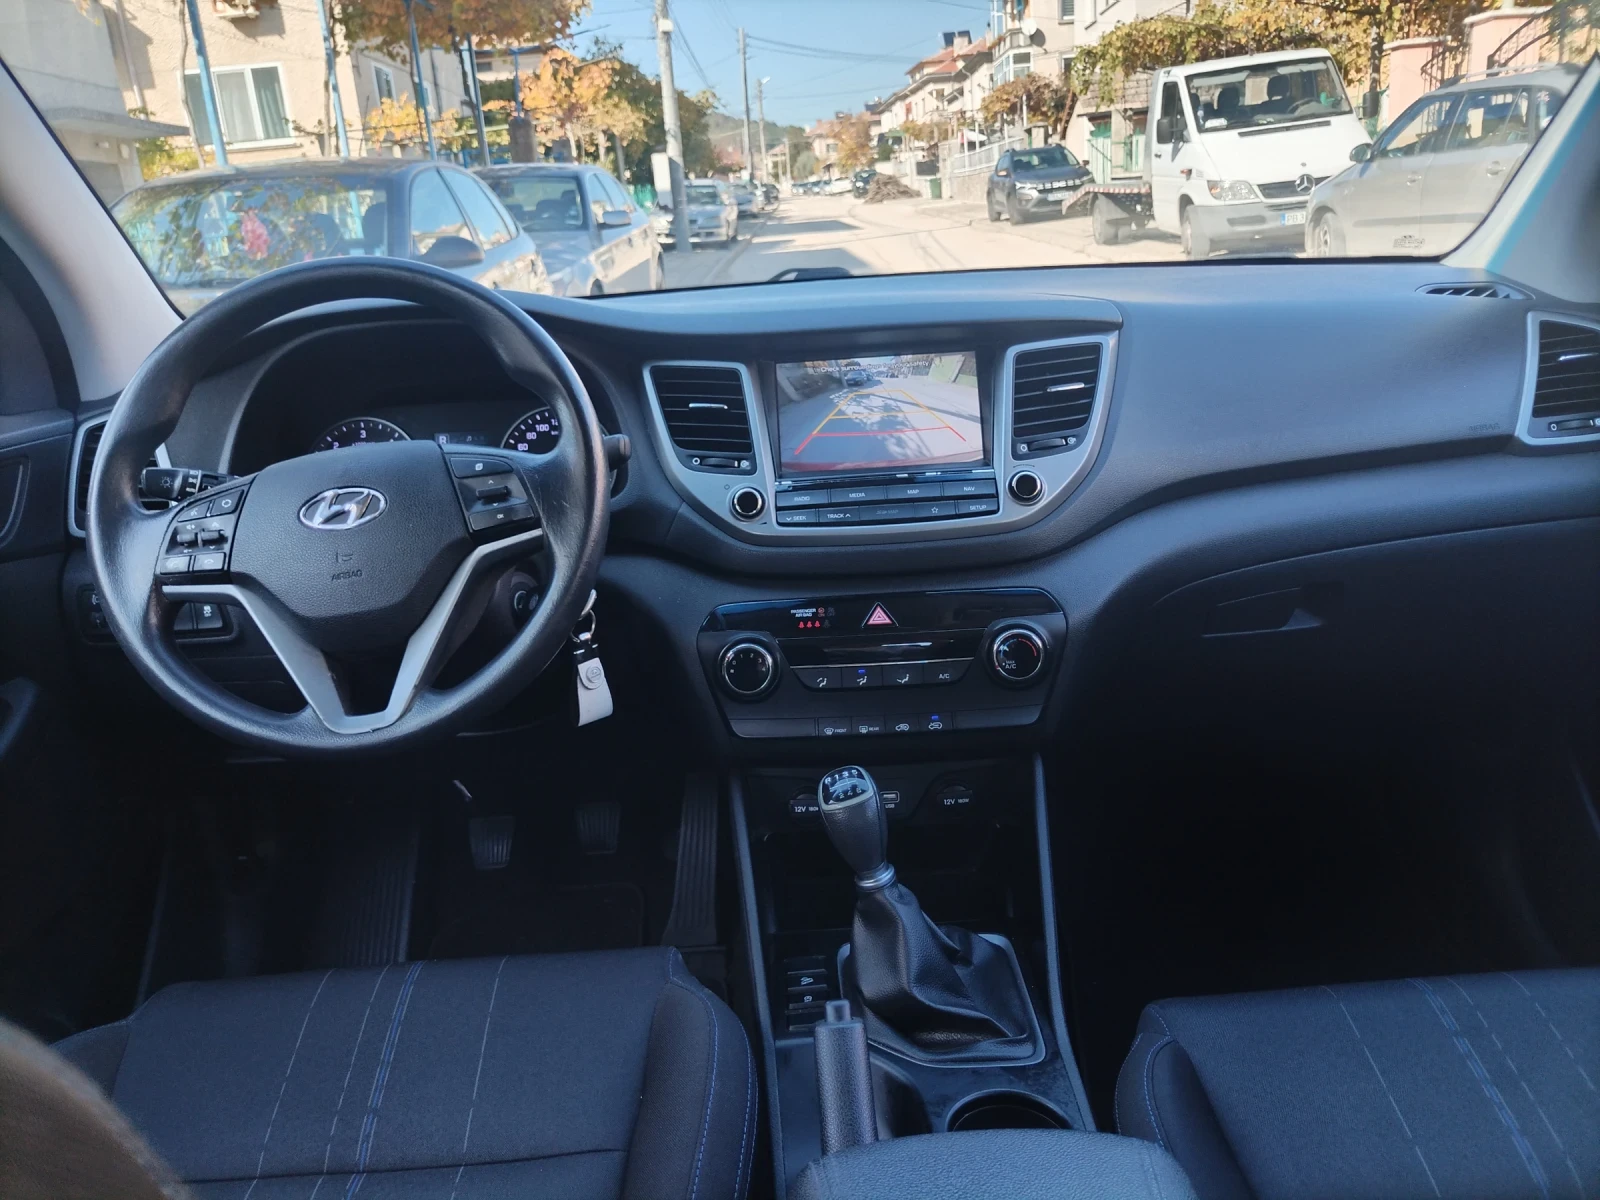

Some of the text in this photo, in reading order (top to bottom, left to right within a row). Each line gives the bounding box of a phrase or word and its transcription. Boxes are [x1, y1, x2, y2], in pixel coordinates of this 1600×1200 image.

[535, 423, 550, 432] 100
[360, 429, 367, 439] 3
[526, 431, 537, 440] 80
[439, 435, 447, 444] R
[333, 441, 340, 449] 2
[331, 569, 363, 581] AIRBAG
[825, 776, 832, 784] R
